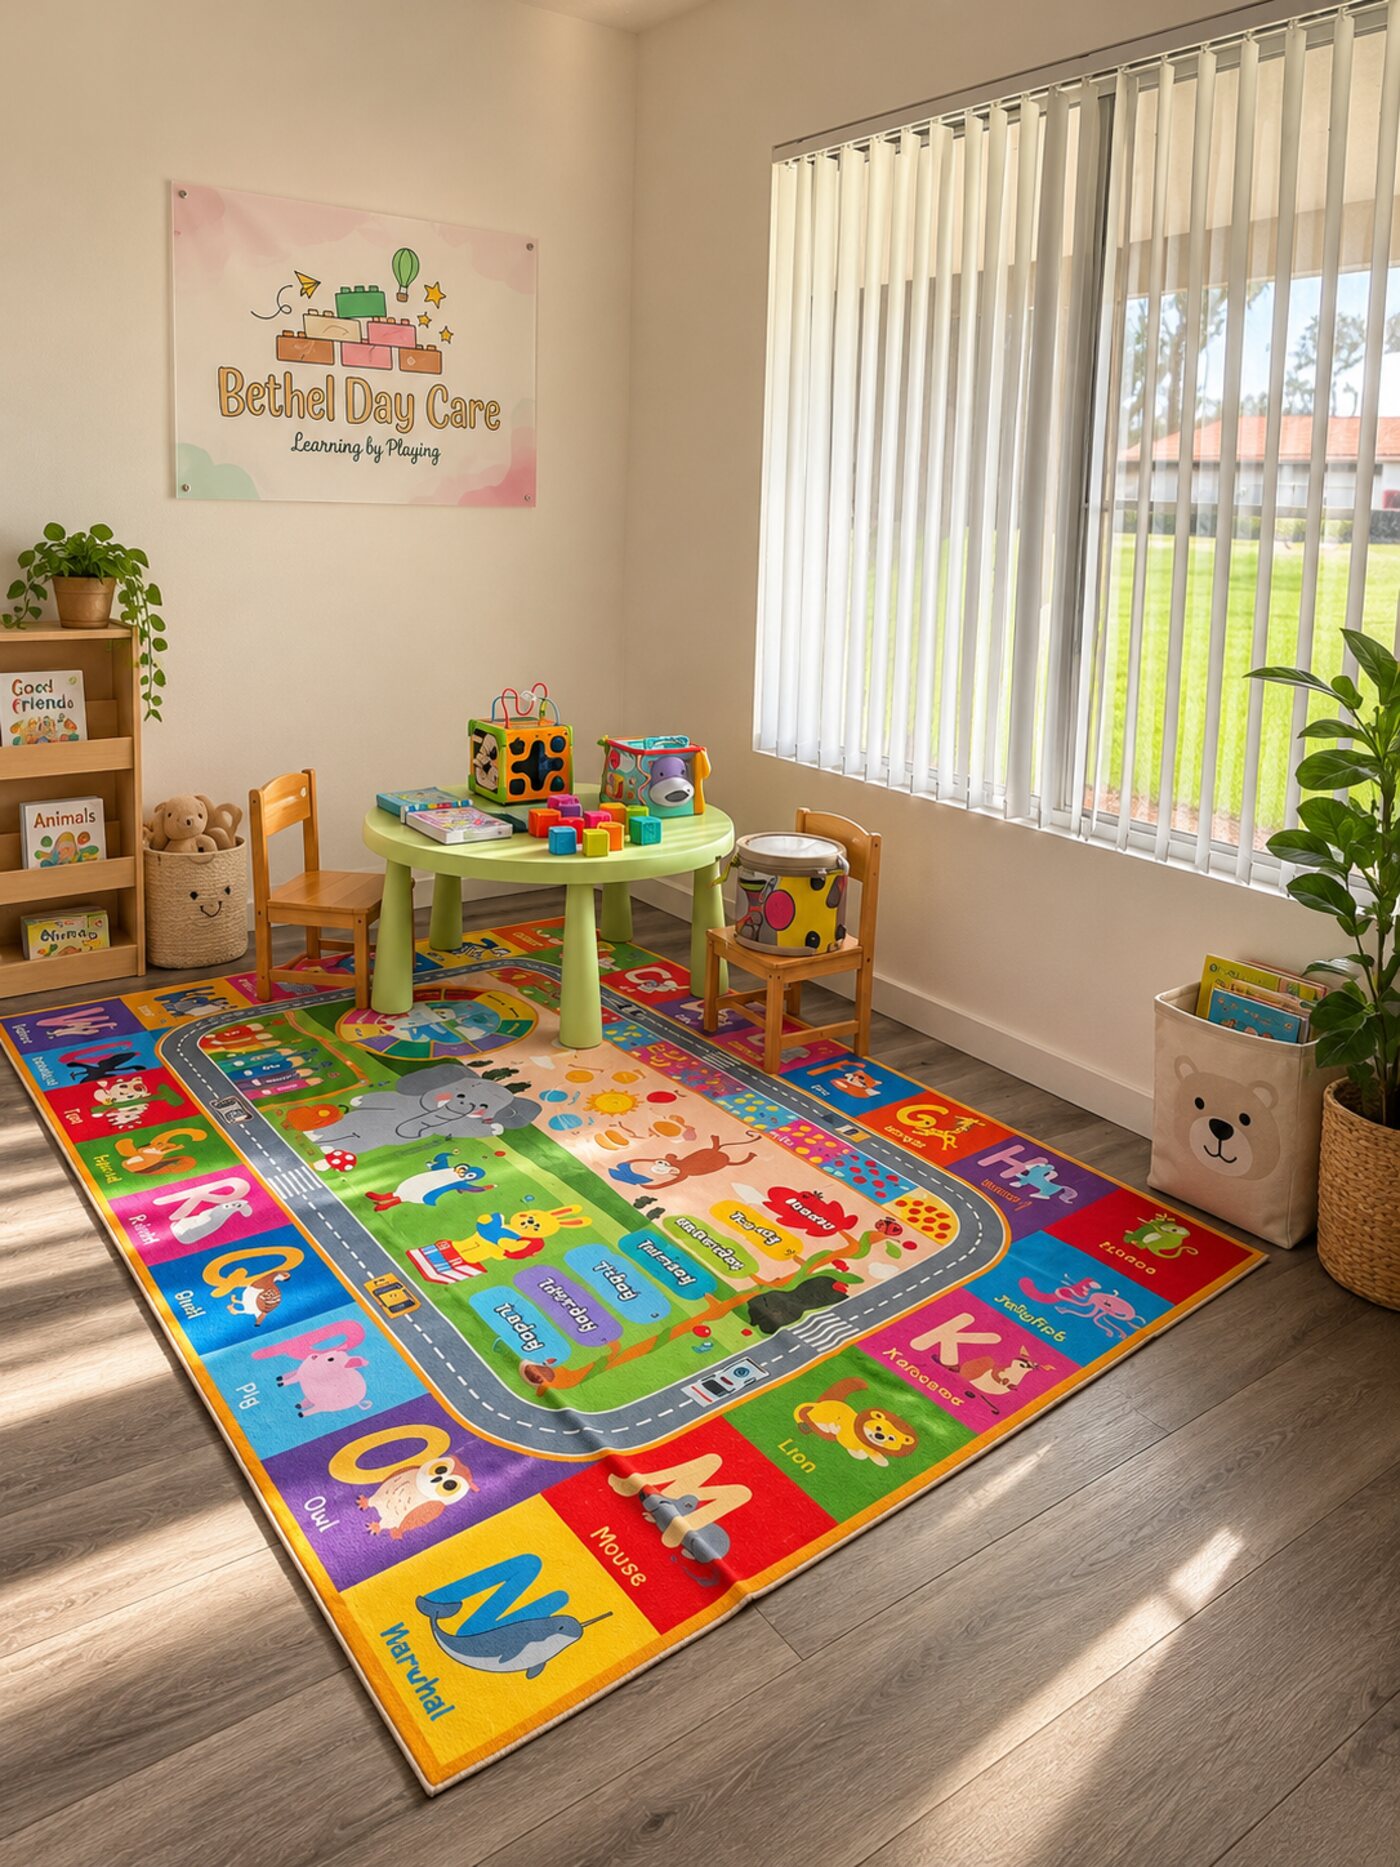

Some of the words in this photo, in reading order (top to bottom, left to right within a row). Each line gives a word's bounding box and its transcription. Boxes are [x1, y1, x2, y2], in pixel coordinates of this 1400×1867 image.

[217, 365, 336, 423] Bethel
[344, 375, 415, 434] Day
[425, 383, 502, 432] Care
[290, 431, 364, 457] Learning
[365, 435, 384, 463] by
[385, 437, 442, 465] Playing
[33, 807, 96, 829] Animals
[152, 1177, 251, 1222] R
[202, 1246, 305, 1298] Q
[909, 1312, 1002, 1366] K
[328, 1423, 451, 1485] O
[303, 1495, 341, 1534] Owl
[607, 1453, 753, 1549] M
[589, 1525, 647, 1588] Mouse
[421, 1553, 570, 1637] N
